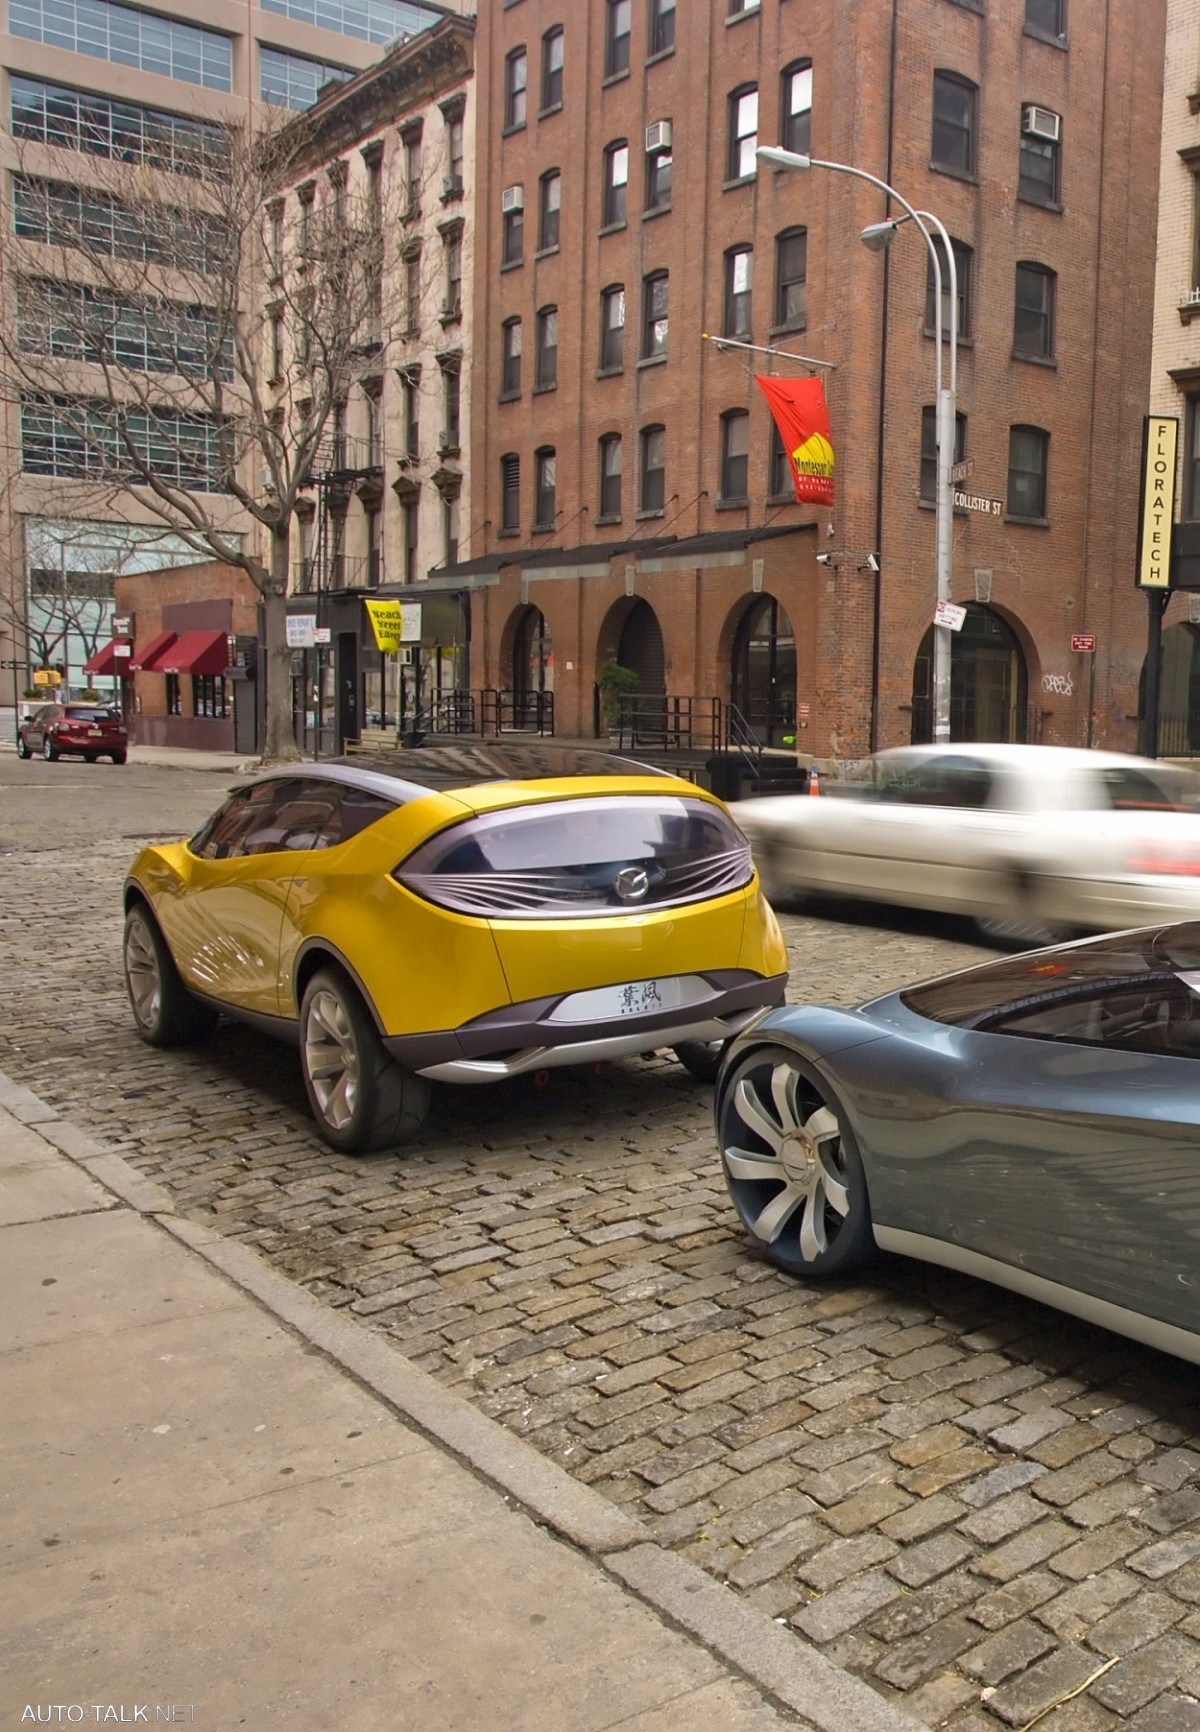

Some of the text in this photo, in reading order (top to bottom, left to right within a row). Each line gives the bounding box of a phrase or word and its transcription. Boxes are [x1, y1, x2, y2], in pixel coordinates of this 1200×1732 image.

[954, 492, 1002, 516] COLLISTER ST
[1149, 424, 1167, 579] FLORATECH
[617, 981, 661, 1007] 葉風
